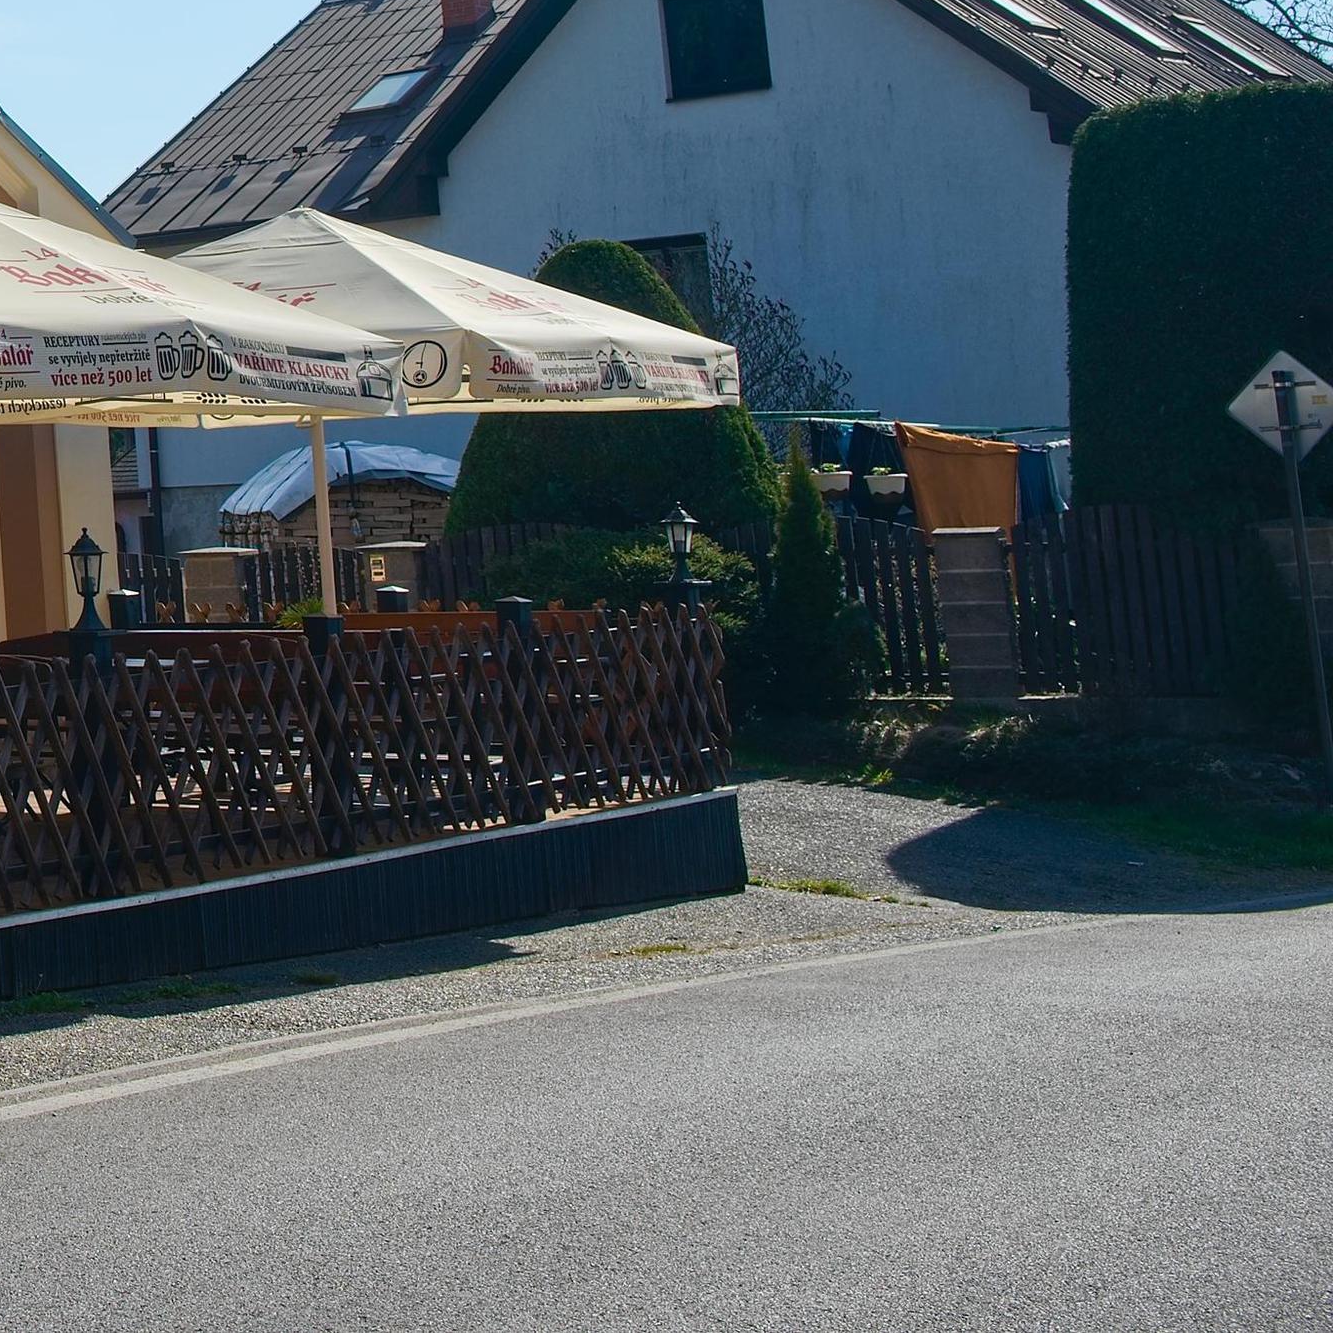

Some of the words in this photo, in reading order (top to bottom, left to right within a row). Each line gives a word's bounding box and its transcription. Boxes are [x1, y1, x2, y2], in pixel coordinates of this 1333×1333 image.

[43, 334, 101, 348] RECEPTURY
[48, 355, 59, 365] se
[60, 352, 97, 366] vyvíjely
[98, 348, 151, 365] nepřetržitě
[234, 351, 287, 374] VAŘÍME
[288, 361, 351, 381] KLASICKY
[4, 380, 27, 391] pivo.
[51, 369, 77, 387] více
[81, 368, 105, 385] než
[108, 370, 132, 387] 500
[135, 366, 153, 383] let
